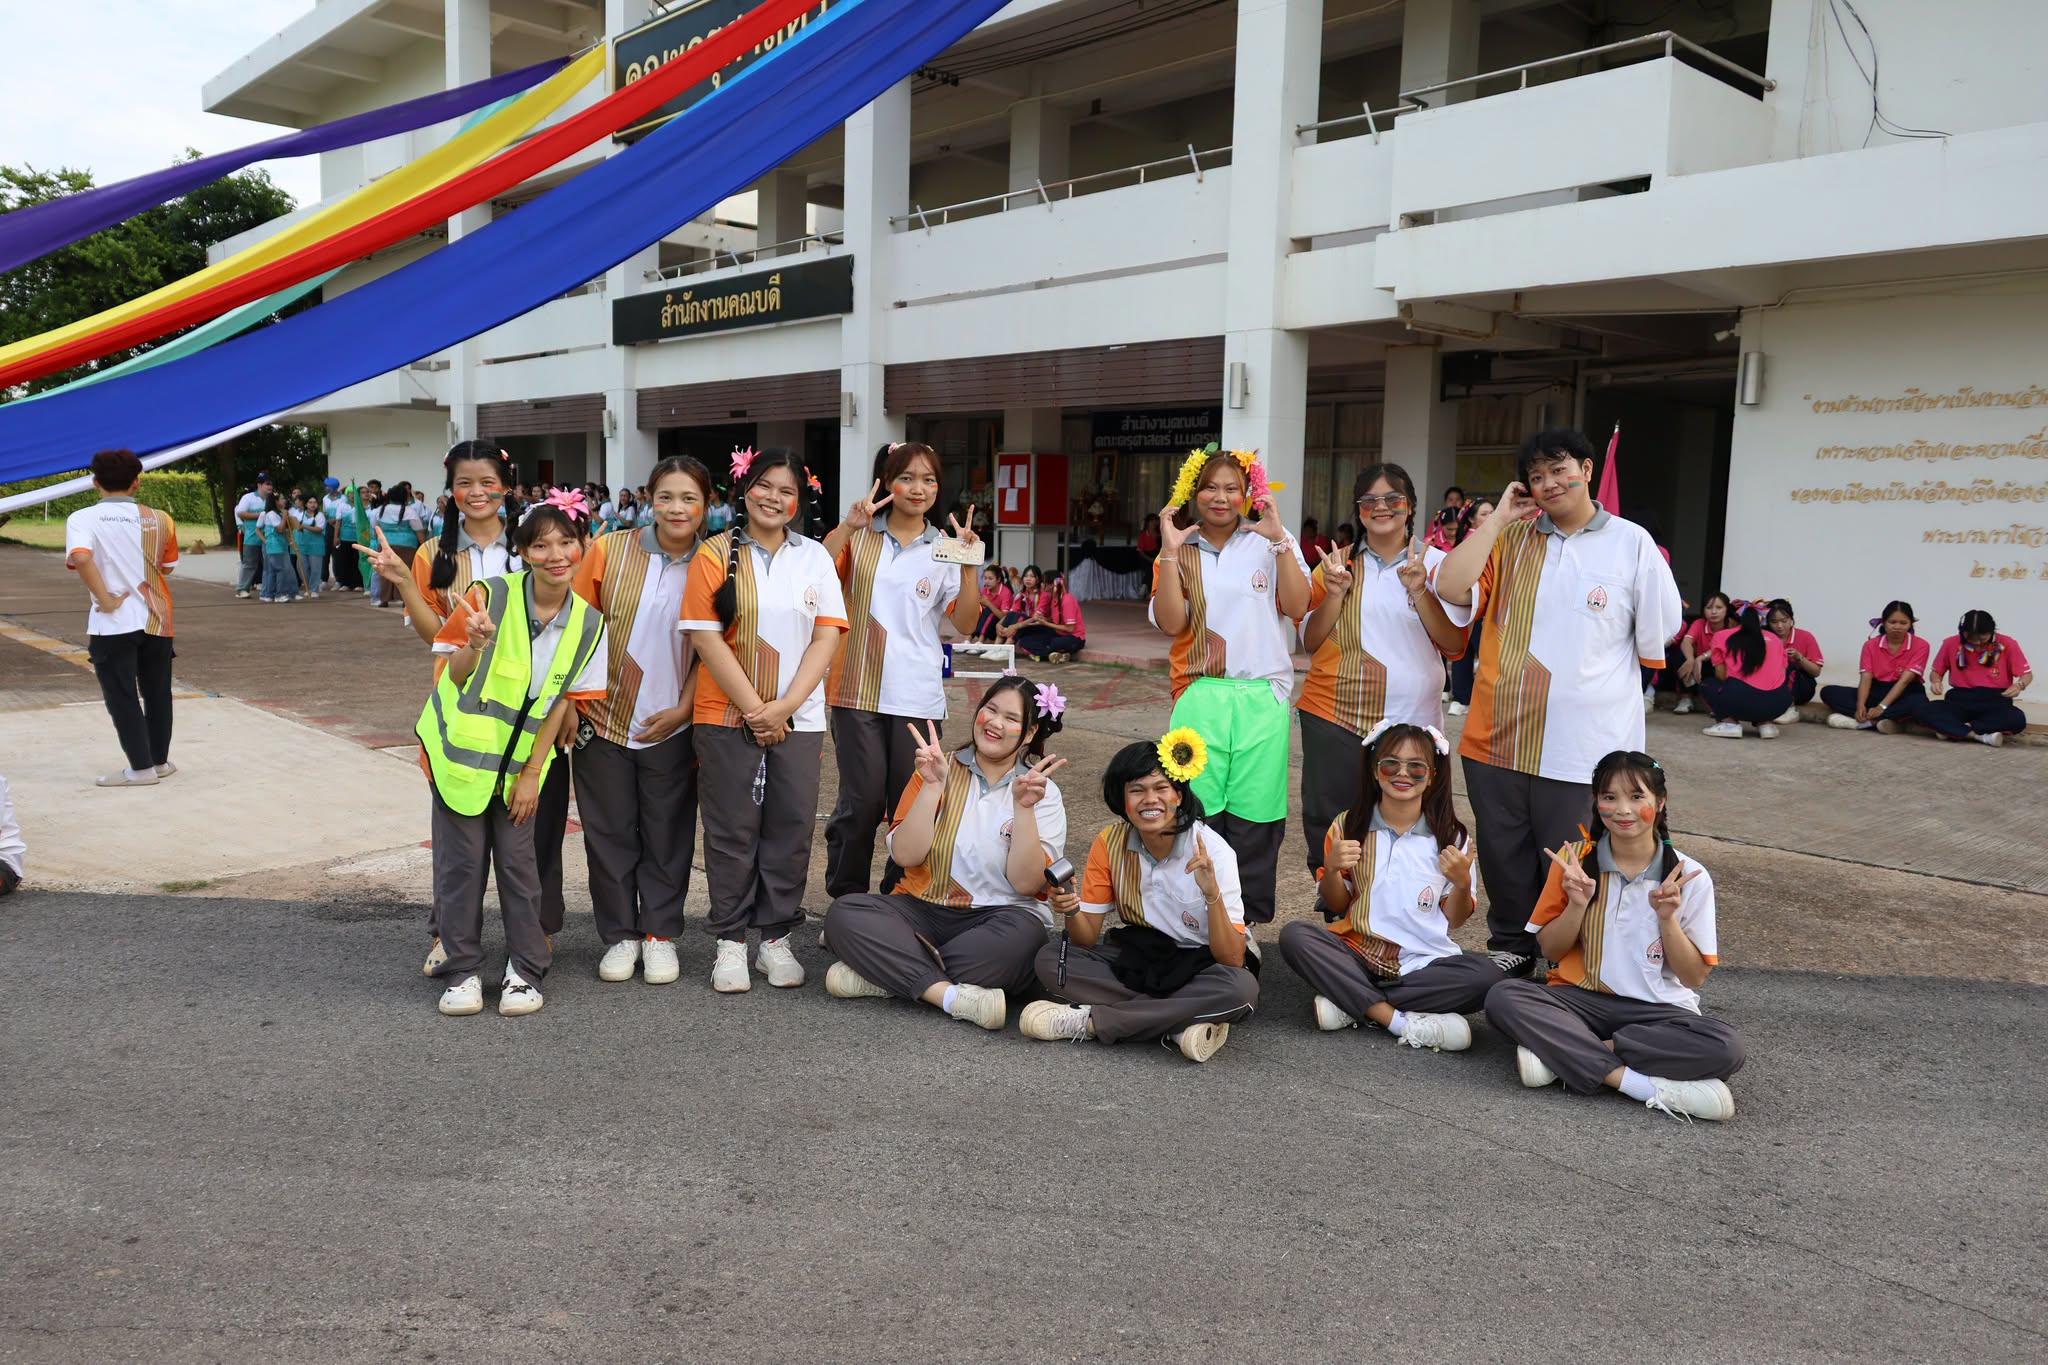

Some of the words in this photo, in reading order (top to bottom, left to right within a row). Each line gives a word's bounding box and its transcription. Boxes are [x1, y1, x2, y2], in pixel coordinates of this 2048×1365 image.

[660, 272, 782, 328] สำนักงานคณบดี
[1121, 411, 1210, 431] สำนักงานคณบดี
[1095, 430, 1172, 450] คณะครุศาสตร์
